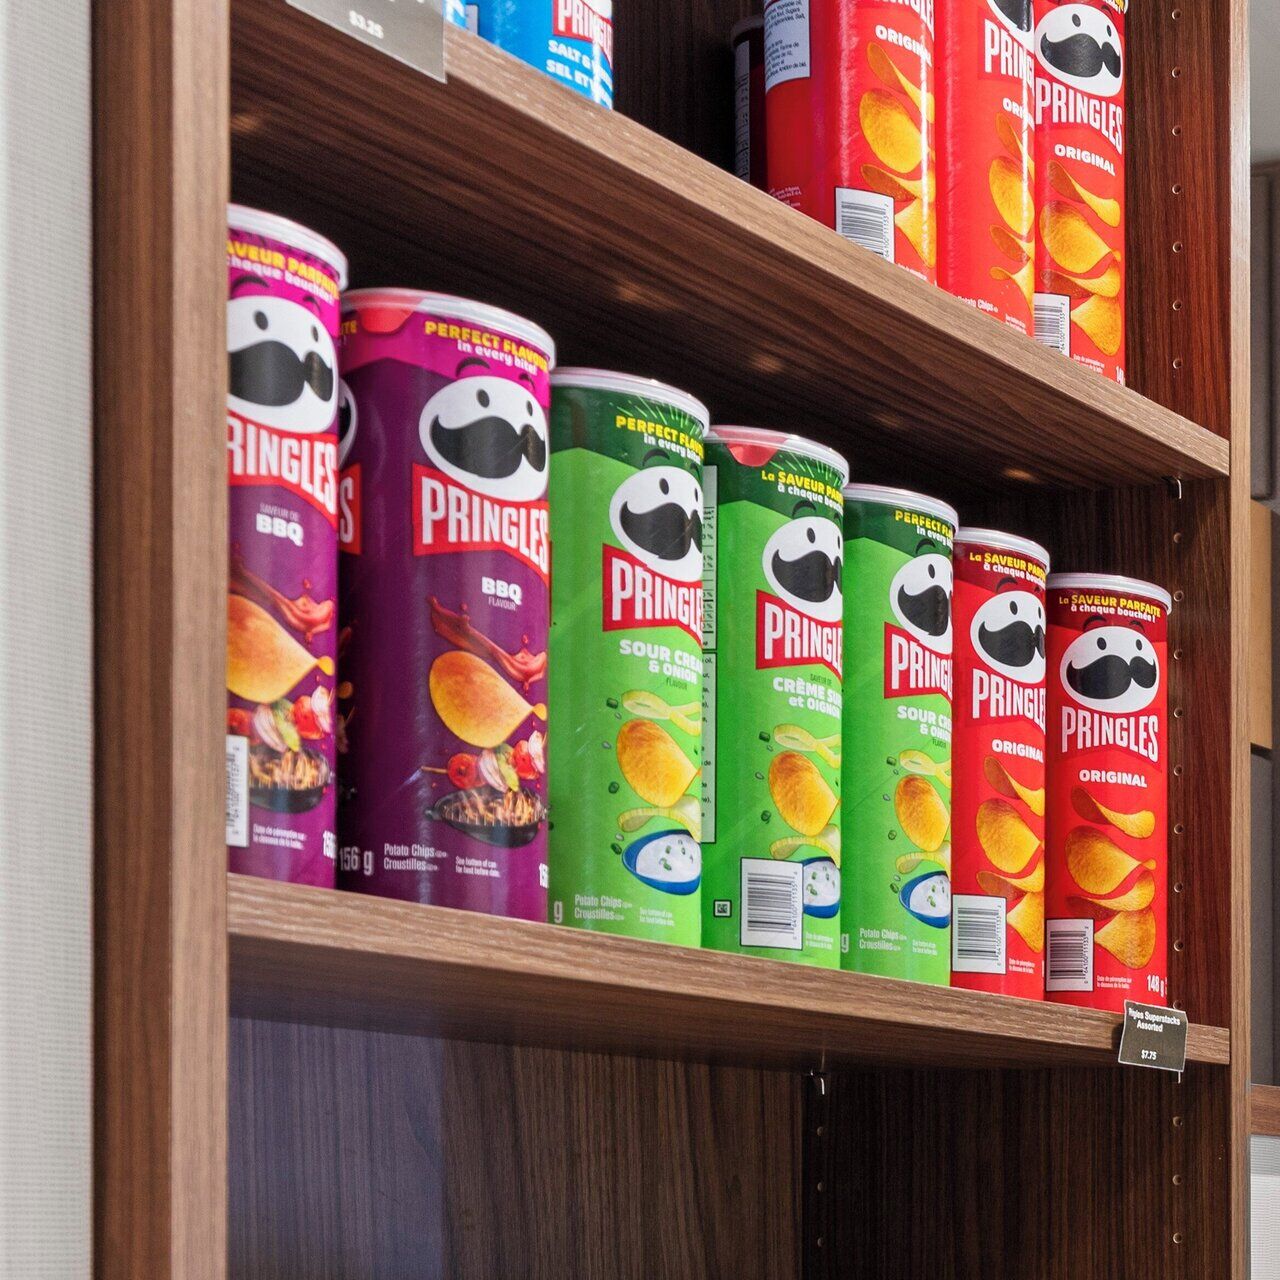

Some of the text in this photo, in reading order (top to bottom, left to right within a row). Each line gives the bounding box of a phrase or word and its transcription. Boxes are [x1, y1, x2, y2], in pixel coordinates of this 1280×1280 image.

[350, 10, 384, 39] $3.25
[1035, 77, 1123, 155] PRINGLES
[1054, 144, 1115, 176] ORIGINAL
[424, 320, 503, 354] PERFECT
[615, 415, 679, 441] PERFECT
[761, 470, 825, 494] La SAVEUR
[788, 484, 824, 505] chaque
[255, 513, 304, 547] BBQ
[421, 476, 549, 575] PRINGLES
[895, 510, 941, 532] PERFECT
[984, 553, 1027, 573] SAVEUR
[992, 563, 1026, 580] chaque
[481, 577, 523, 606] BBQ
[1071, 594, 1161, 618] SAVEUR PARFAITE
[1079, 604, 1115, 617] chaque
[619, 639, 672, 663] SOUR
[648, 661, 660, 673] &
[773, 675, 825, 698] CRÈME
[897, 705, 937, 727] SOUR
[1061, 705, 1159, 764] PRINGLES
[1079, 769, 1147, 788] ORIGINAL
[384, 843, 435, 859] Potato Chips
[383, 857, 427, 871] Croustilles
[574, 894, 622, 909] Potato Chips
[574, 907, 616, 921] Croustilles
[1136, 1020, 1164, 1033] Assorted
[1144, 1010, 1181, 1026] Superstacks
[1140, 1049, 1157, 1061] $7.75
